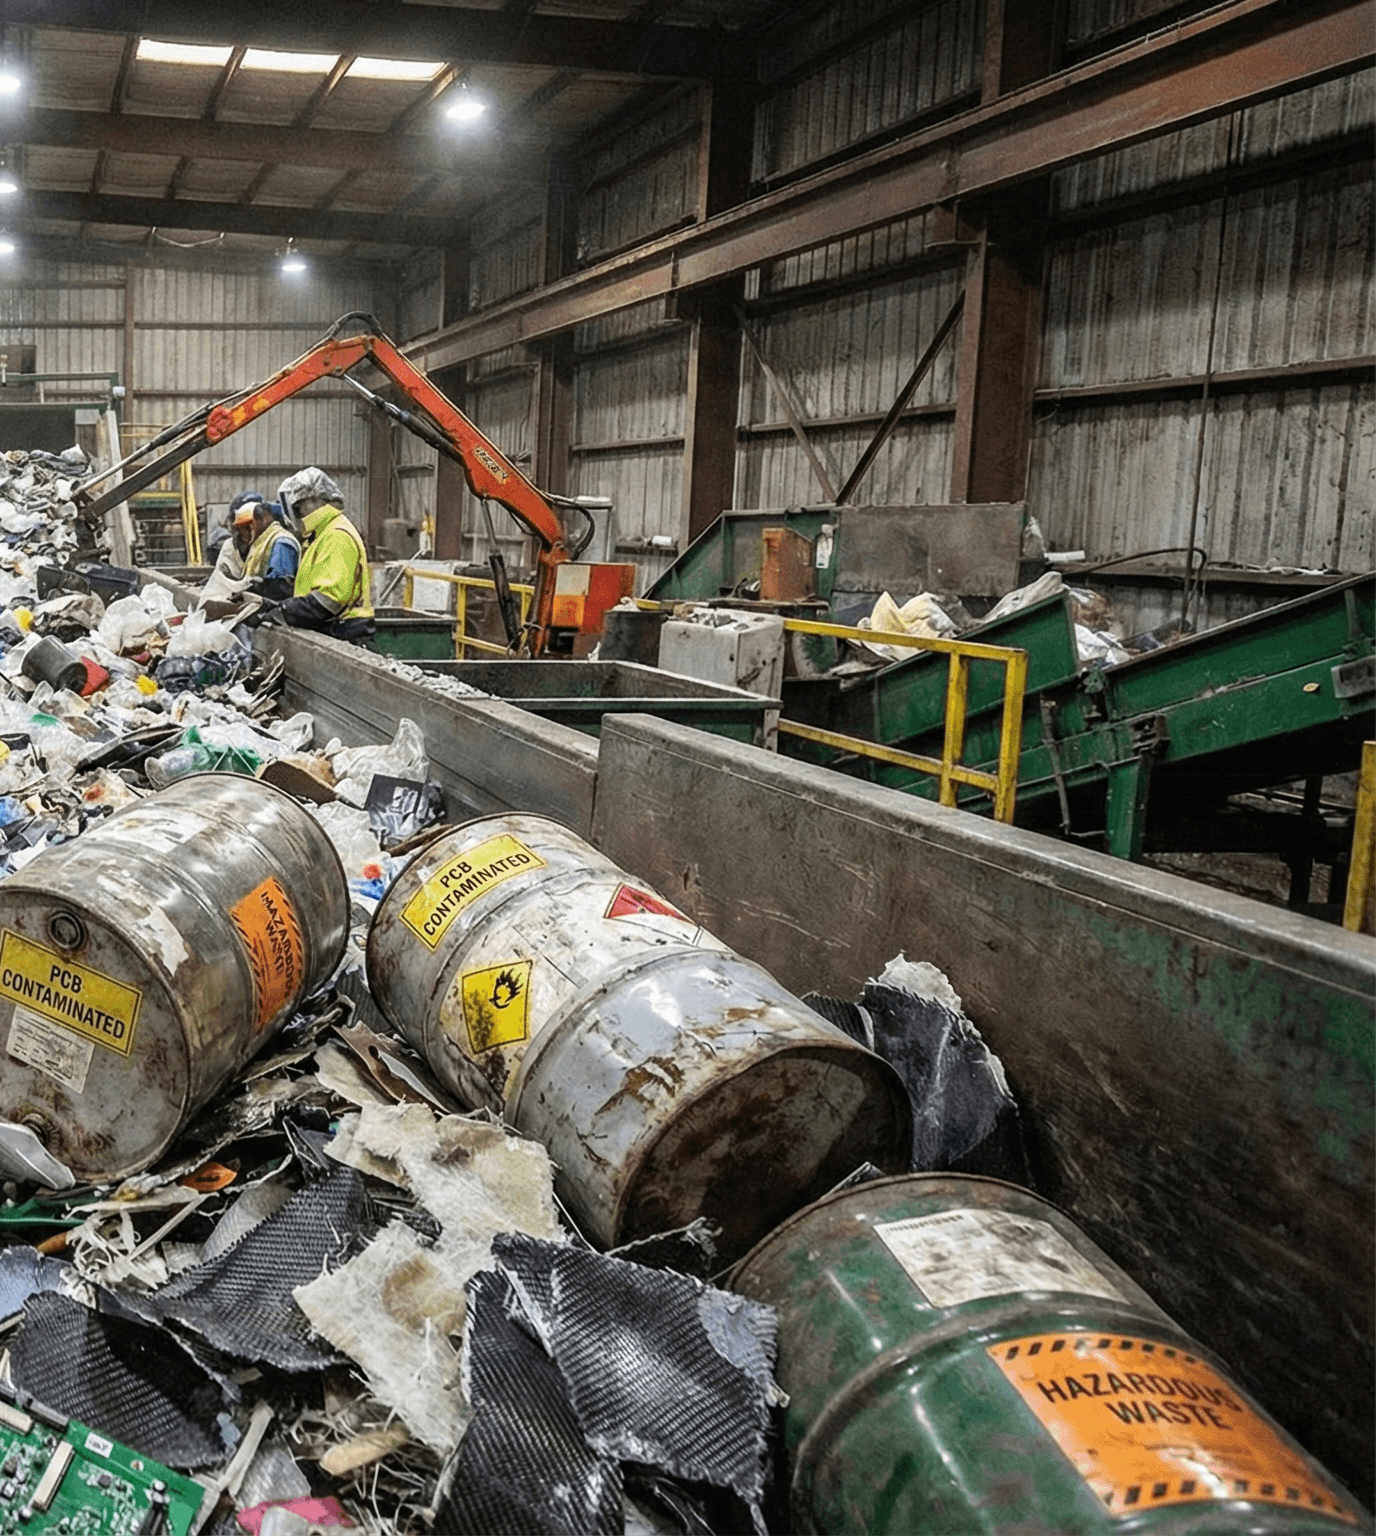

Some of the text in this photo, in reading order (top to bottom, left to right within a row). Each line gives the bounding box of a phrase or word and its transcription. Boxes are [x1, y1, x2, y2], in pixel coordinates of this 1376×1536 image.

[439, 861, 472, 888] PCB
[423, 853, 531, 936] CONTAMINATED
[49, 964, 83, 994] PCB
[2, 968, 125, 1039] CONTAMINATED
[1036, 1371, 1244, 1414] HAZARDOUS
[1104, 1400, 1234, 1432] WASTE
